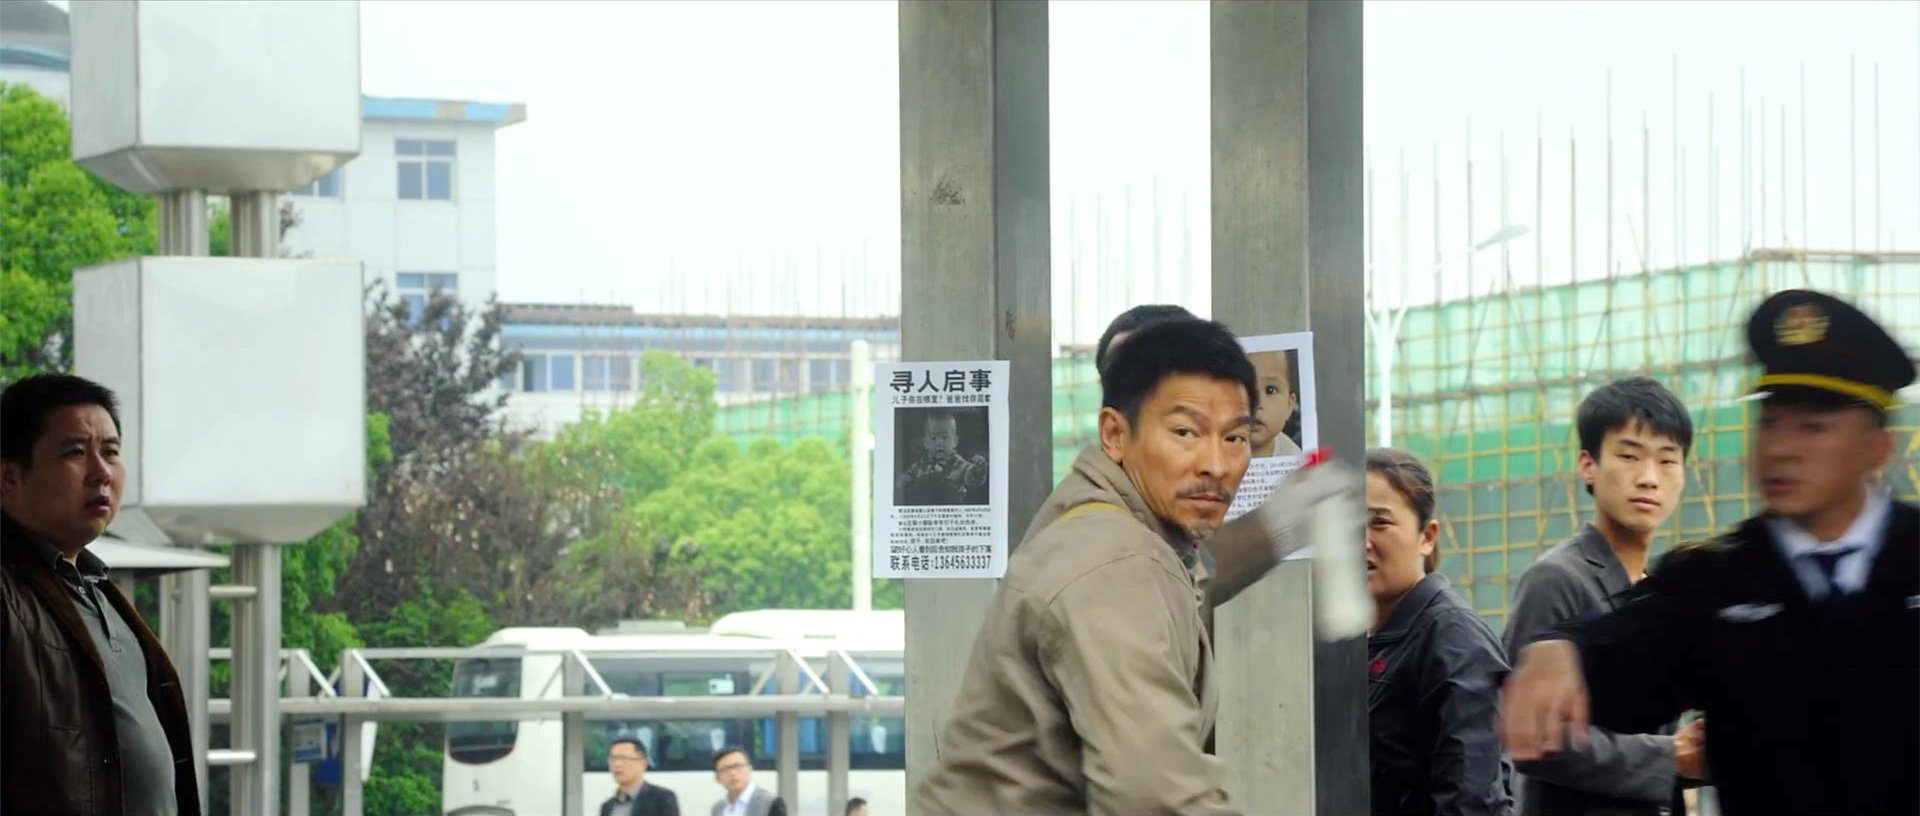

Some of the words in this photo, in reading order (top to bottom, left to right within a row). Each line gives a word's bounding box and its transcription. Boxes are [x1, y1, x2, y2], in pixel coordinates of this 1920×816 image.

[890, 369, 992, 393] 寻人启事
[890, 555, 992, 571] 联系电话:13645633337
